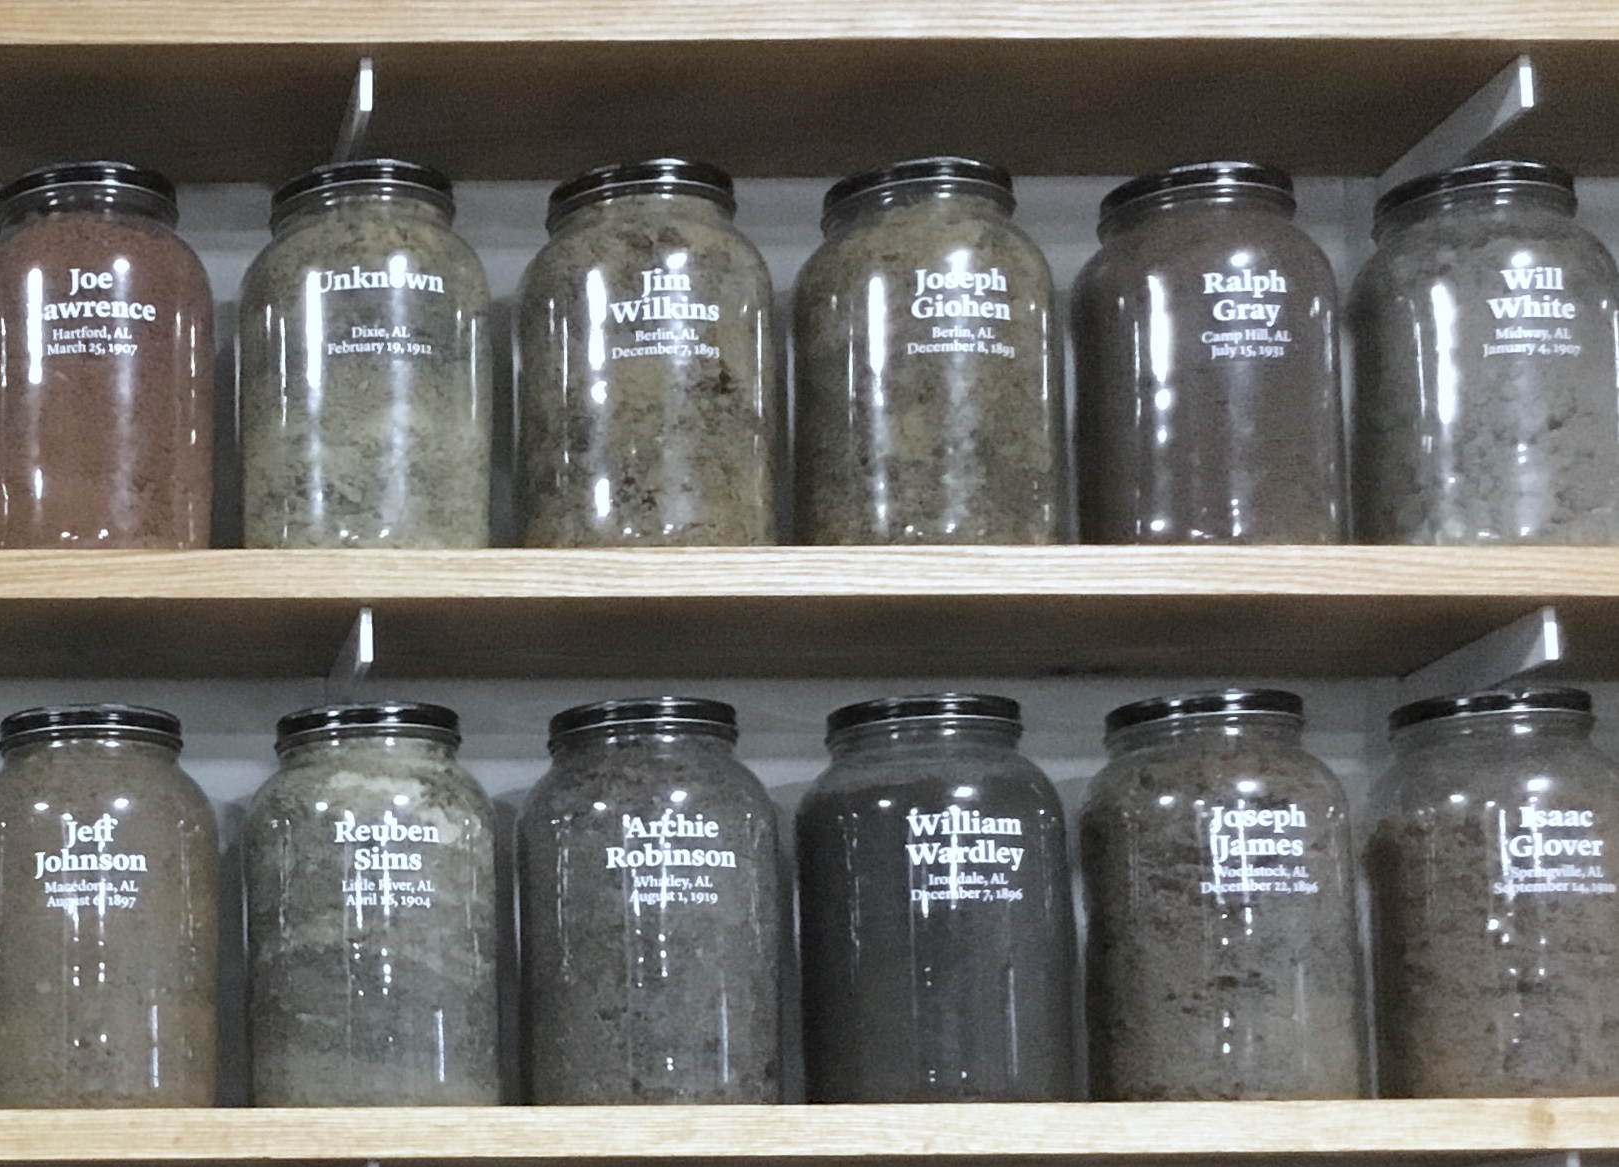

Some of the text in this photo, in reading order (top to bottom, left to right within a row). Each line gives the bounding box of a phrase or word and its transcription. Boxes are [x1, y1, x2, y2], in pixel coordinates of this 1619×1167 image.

[69, 268, 113, 295] Joe
[642, 268, 691, 296] Jim
[914, 267, 1007, 296] Joseph
[1203, 269, 1287, 298] Ralph
[1500, 267, 1563, 291] Will
[34, 300, 156, 321] awrence
[610, 296, 719, 323] Wilkins
[1213, 299, 1281, 326] Gray
[1487, 295, 1575, 319] White
[52, 327, 132, 341] Hartford, AL
[352, 326, 410, 339] Dixie, AL
[47, 341, 138, 356] March 25, 1907
[327, 341, 432, 356] February 19, 1912
[334, 818, 439, 843] Reuben
[626, 814, 719, 838] Archie
[906, 811, 1022, 836] William
[1210, 804, 1307, 833] Joseph
[67, 818, 118, 848] Jeff
[1509, 833, 1604, 857] Glover
[354, 847, 422, 871] Sims
[606, 843, 736, 868] Robinson
[905, 840, 1024, 871] Wardley
[1217, 835, 1303, 863] James
[35, 849, 147, 879] Johnson
